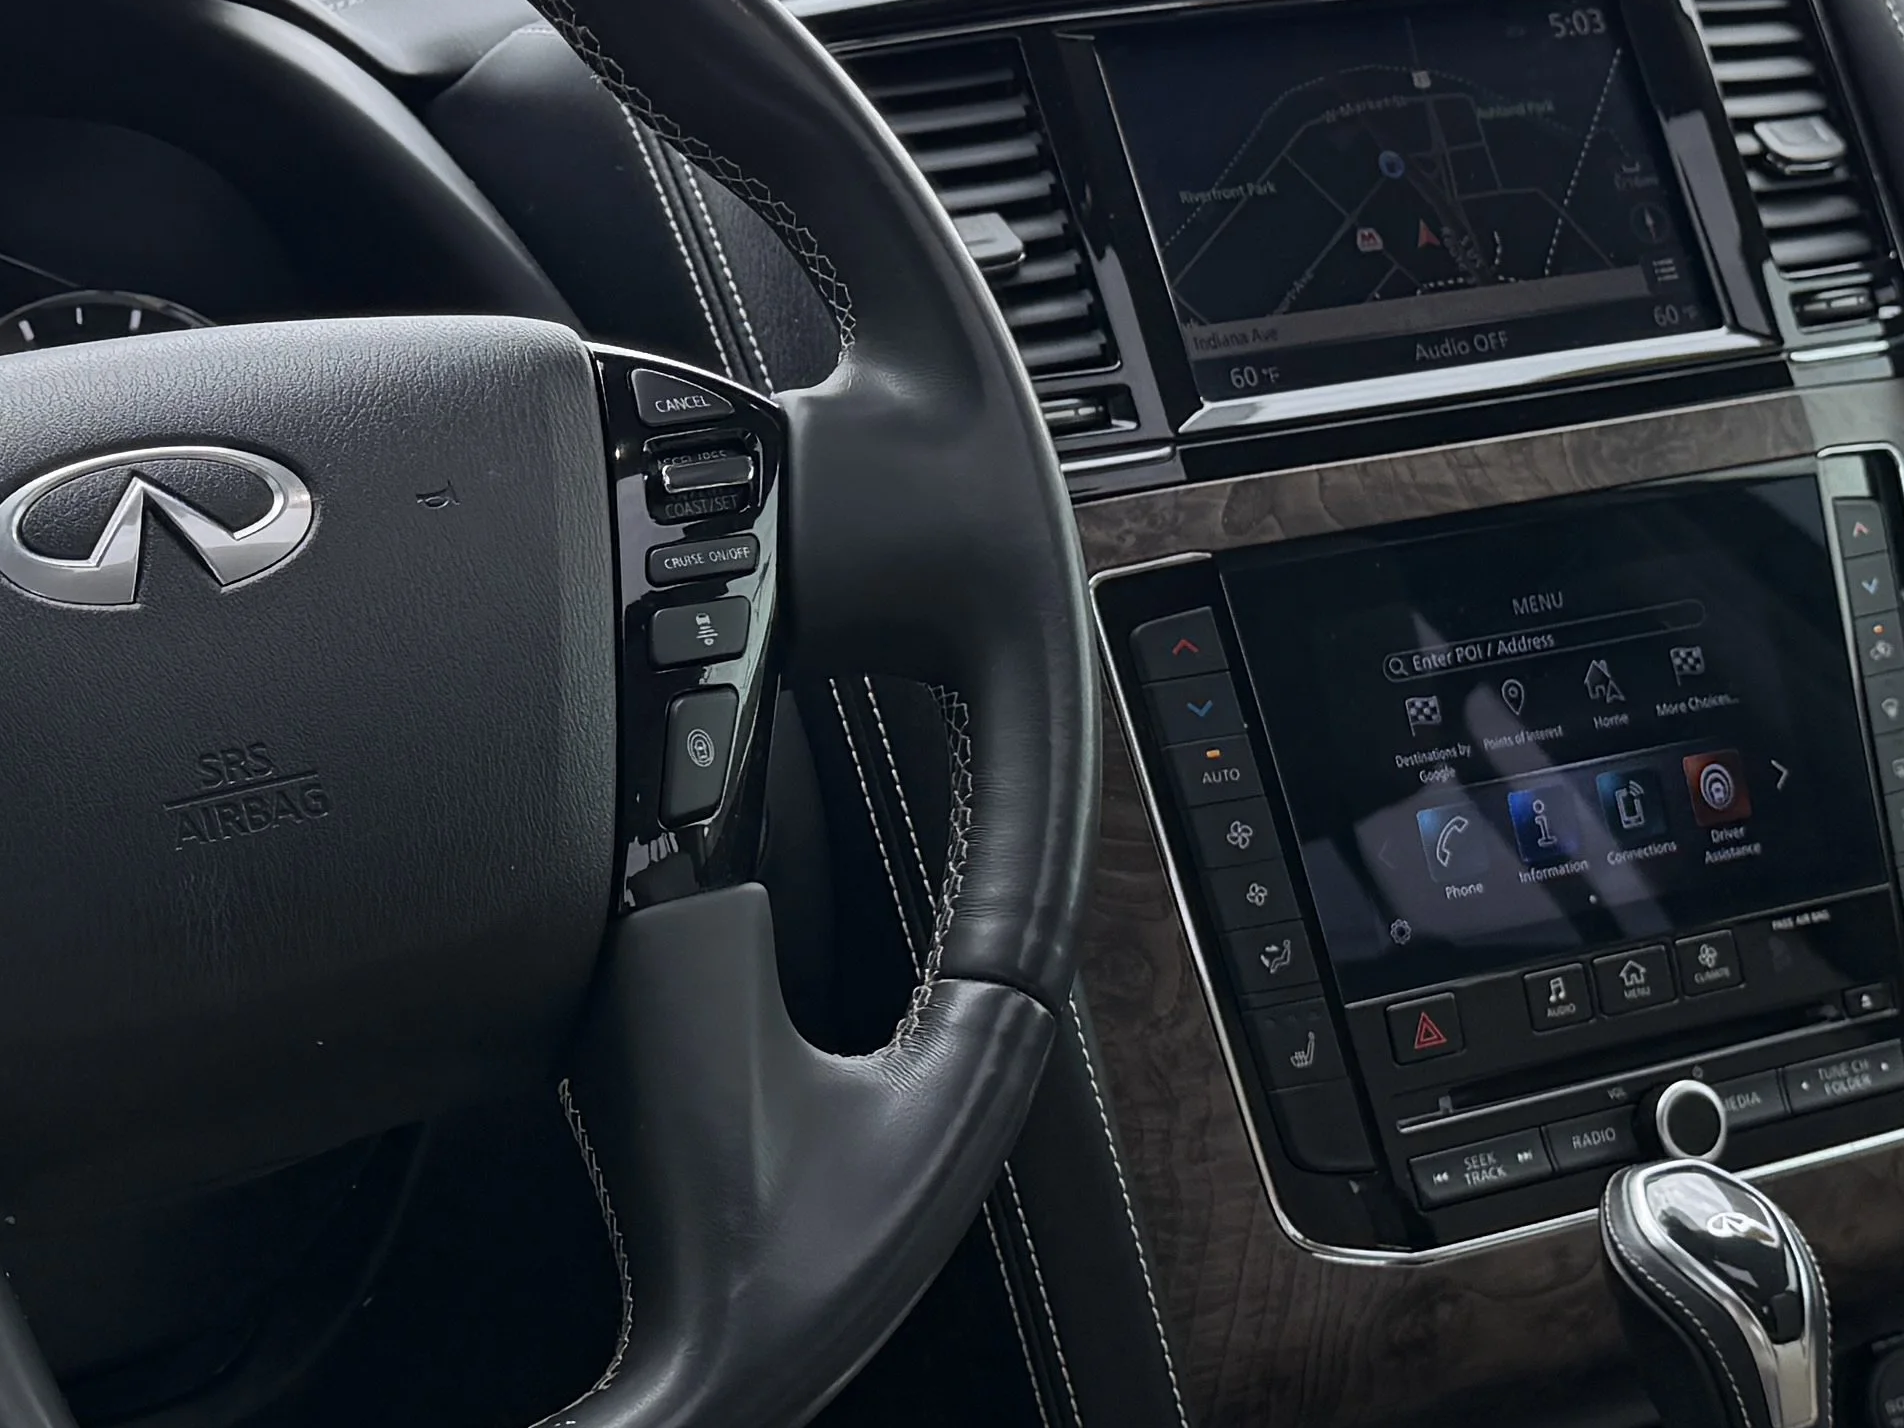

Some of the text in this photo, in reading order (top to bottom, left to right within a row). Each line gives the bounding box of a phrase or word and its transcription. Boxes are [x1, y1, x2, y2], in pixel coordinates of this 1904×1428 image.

[1547, 6, 1608, 39] 5:03
[1179, 180, 1277, 206] Riverfront Park
[1193, 325, 1279, 352] Indiana Ave
[1413, 329, 1510, 363] Audio OFF
[654, 394, 713, 415] CANCEL
[664, 546, 751, 571] CRUISE ON/OFF
[1511, 590, 1564, 617] MENU
[1411, 650, 1453, 675] Enter
[1455, 642, 1483, 664] POI
[1496, 632, 1555, 656] Address
[1593, 712, 1629, 731] Home
[1656, 699, 1687, 719] More
[1483, 724, 1564, 752] Points of Interest
[199, 743, 274, 790] SRS
[1394, 741, 1472, 770] Destinations by
[1202, 767, 1241, 785] AUTO
[1419, 765, 1456, 785] Google
[175, 785, 332, 852] AIRBAG
[1710, 824, 1746, 844] Driver
[1607, 839, 1678, 867] Connections
[1704, 841, 1763, 866] Assistance
[1518, 858, 1590, 885] Information
[1444, 880, 1484, 900] Phone
[1622, 984, 1652, 1002] MENU
[1546, 1002, 1577, 1019] AUDIO
[1824, 1072, 1872, 1097] FOLDER
[1571, 1126, 1617, 1151] RADIO
[1463, 1151, 1497, 1171] SEEK
[1464, 1166, 1507, 1187] TRACK
